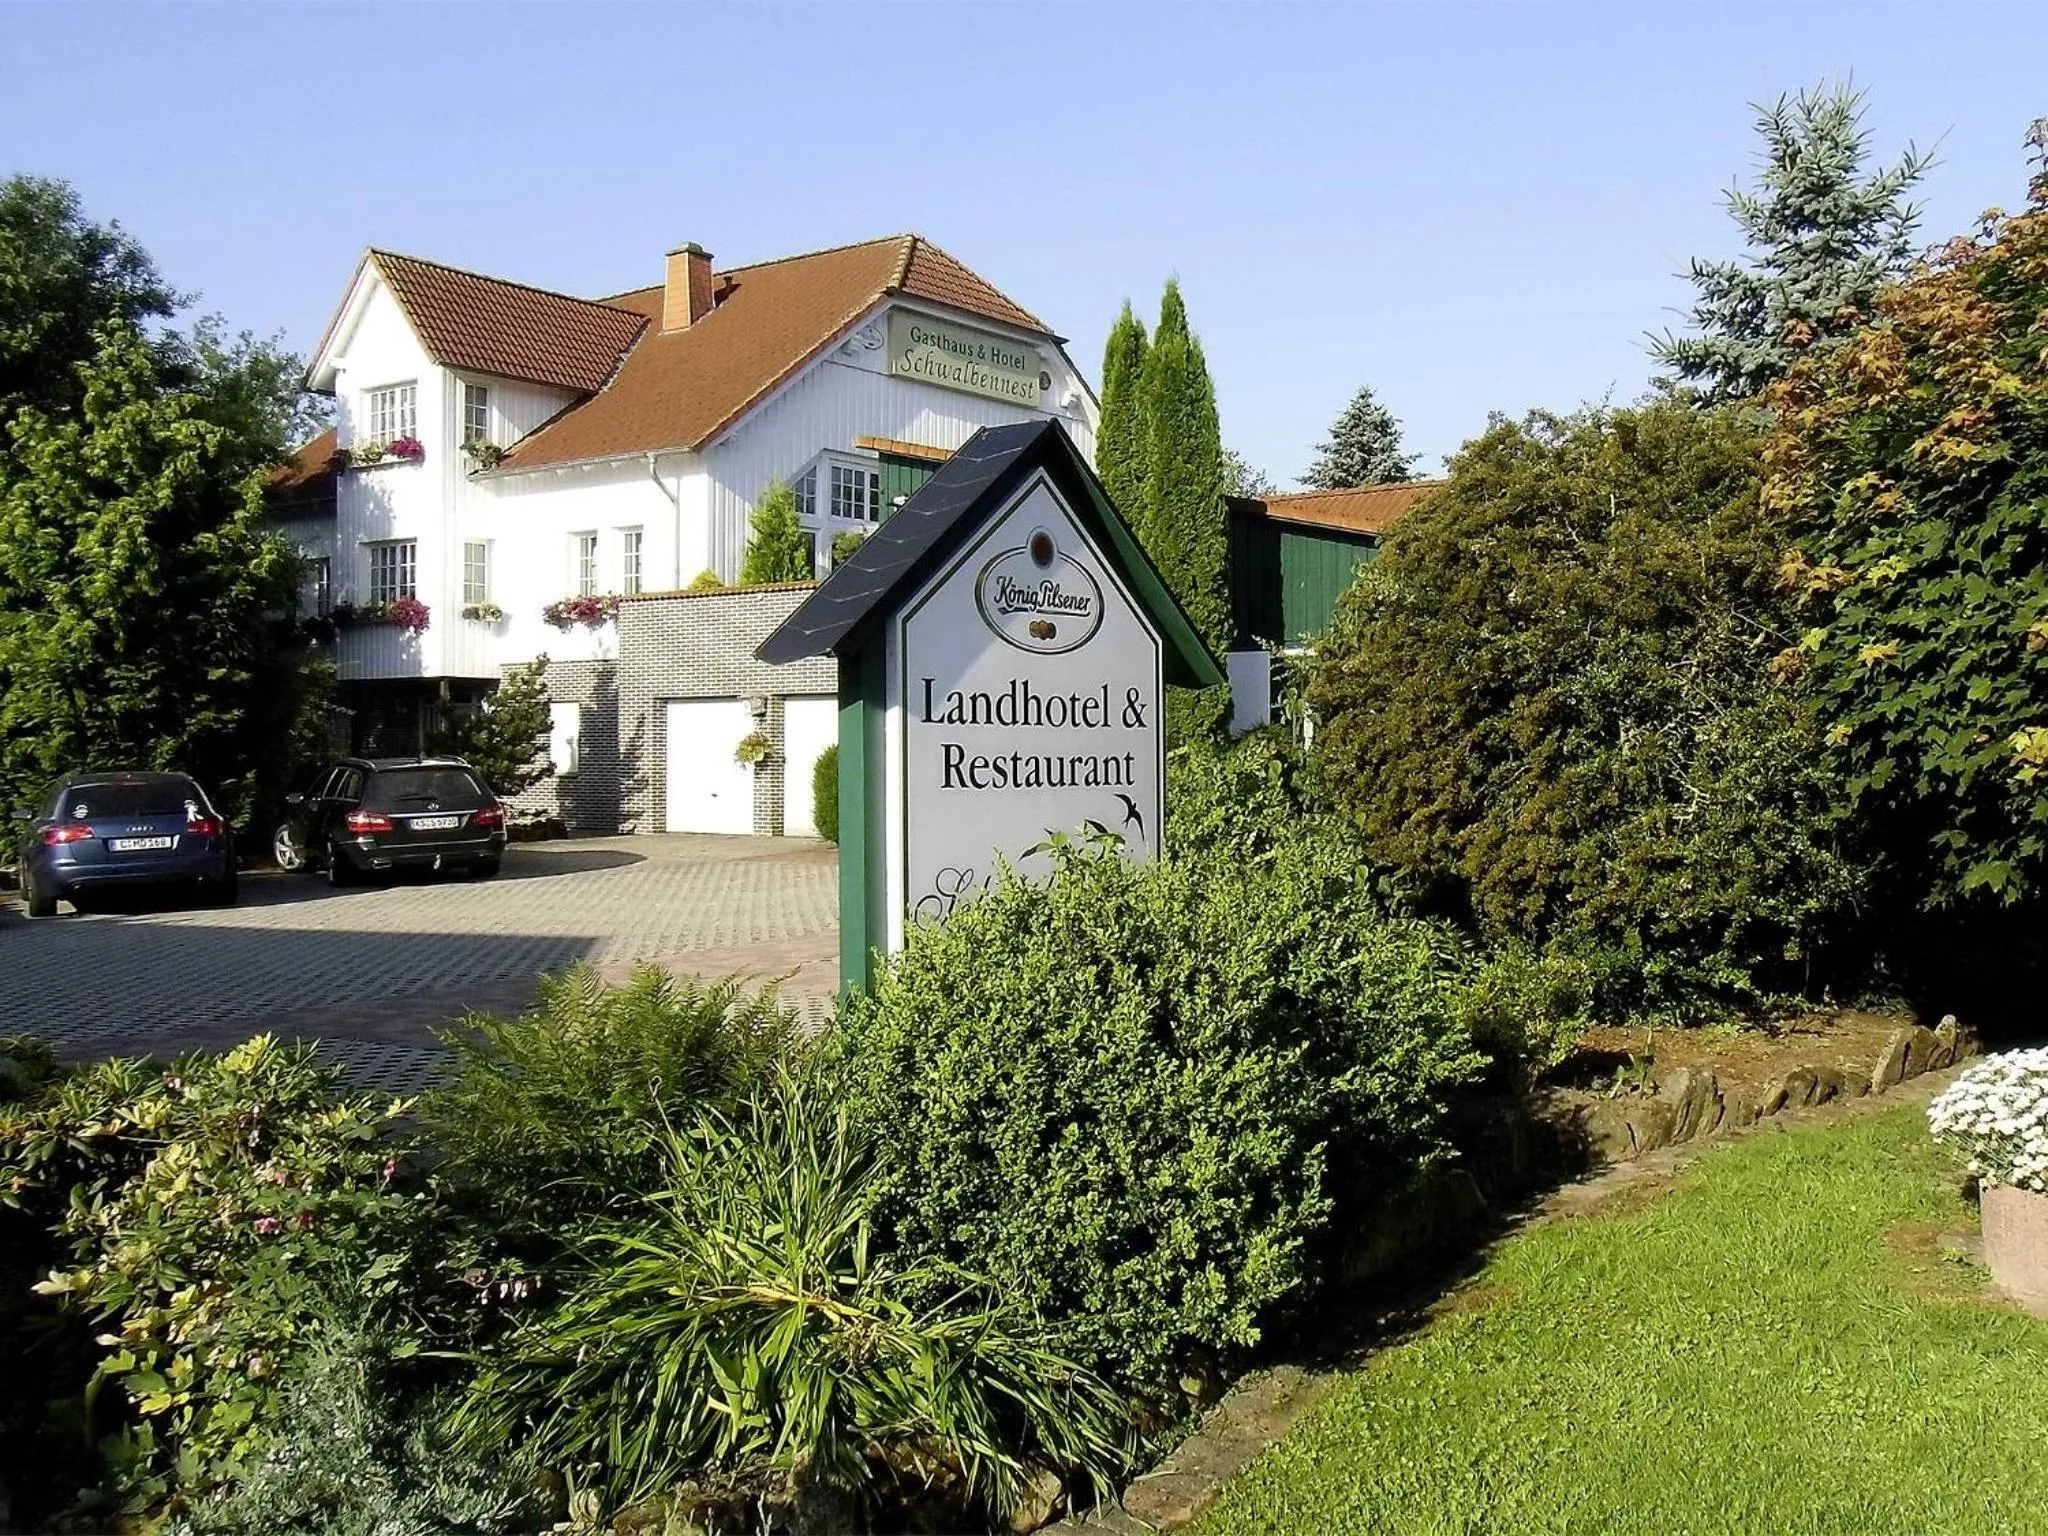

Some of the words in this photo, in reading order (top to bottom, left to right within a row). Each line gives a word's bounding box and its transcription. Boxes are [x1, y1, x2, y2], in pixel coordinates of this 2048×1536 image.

[910, 326, 973, 358] Gasthaus
[977, 343, 986, 359] &
[991, 347, 1025, 370] Hotel
[900, 349, 1034, 400] Schwalbennest
[994, 575, 1038, 612] König
[1038, 579, 1091, 612] Pilsener
[920, 677, 1111, 729] Landhotel
[1121, 686, 1148, 729] &
[940, 742, 1135, 789] Restaurant
